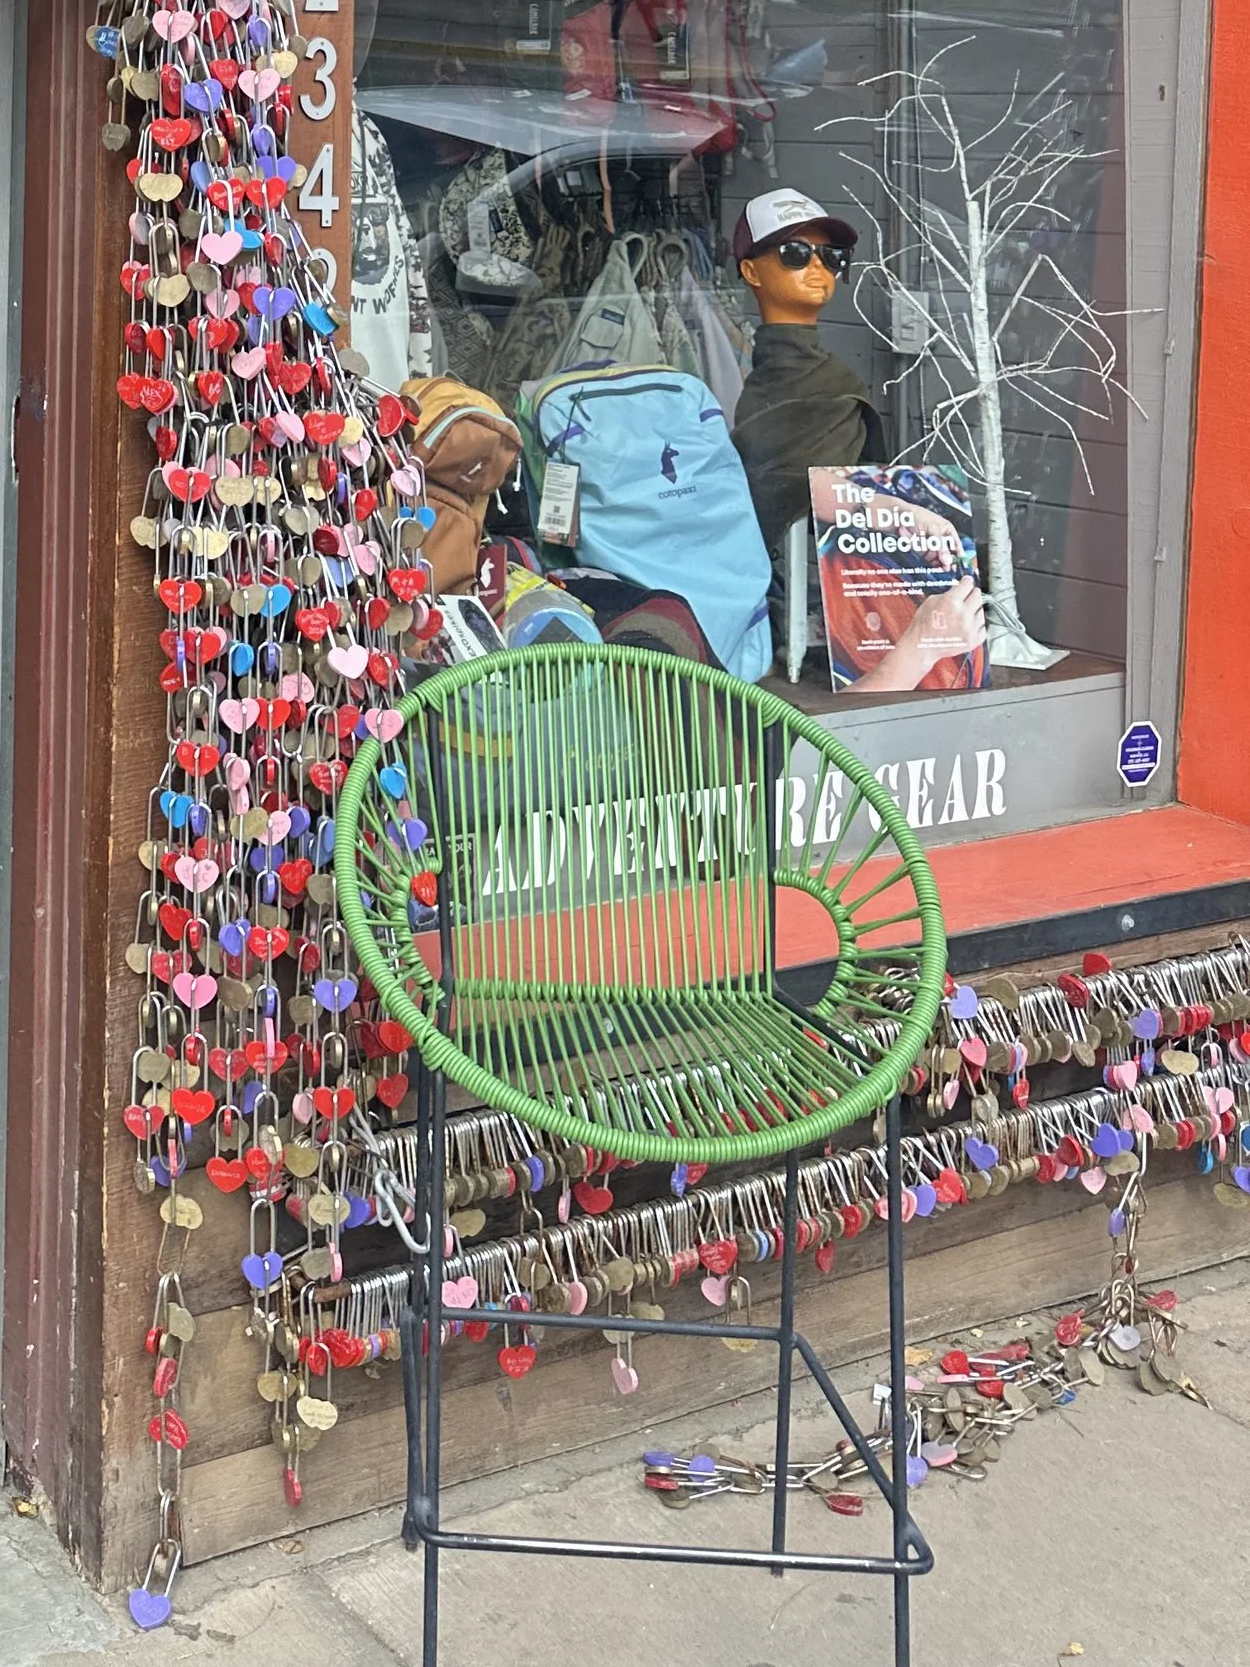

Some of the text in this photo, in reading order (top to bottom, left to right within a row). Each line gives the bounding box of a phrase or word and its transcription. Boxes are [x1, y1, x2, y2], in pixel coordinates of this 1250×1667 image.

[658, 485, 697, 500] cotopaxi
[831, 484, 876, 504] The
[834, 508, 873, 529] Del
[837, 530, 957, 554] Collection
[866, 748, 1008, 832] GEAR
